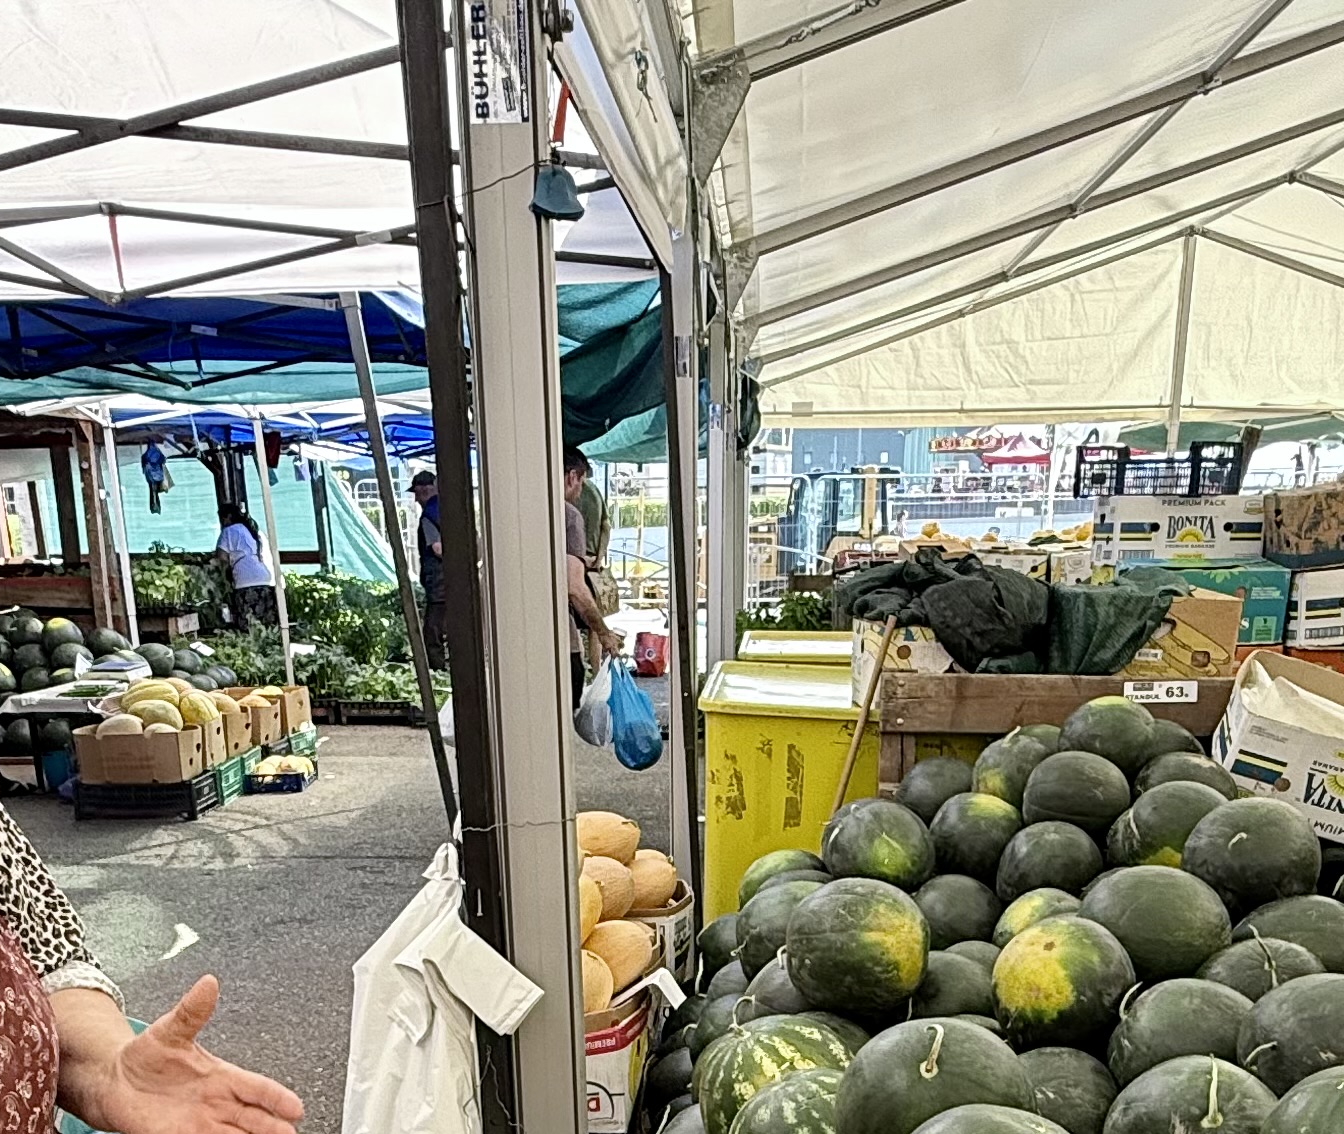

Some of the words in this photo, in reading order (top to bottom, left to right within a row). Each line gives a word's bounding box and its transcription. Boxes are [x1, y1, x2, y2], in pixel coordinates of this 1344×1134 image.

[471, 3, 490, 119] BÜHLER
[1161, 499, 1202, 507] PREMIUM
[1203, 499, 1226, 507] PACK
[1167, 515, 1216, 539] BONITA
